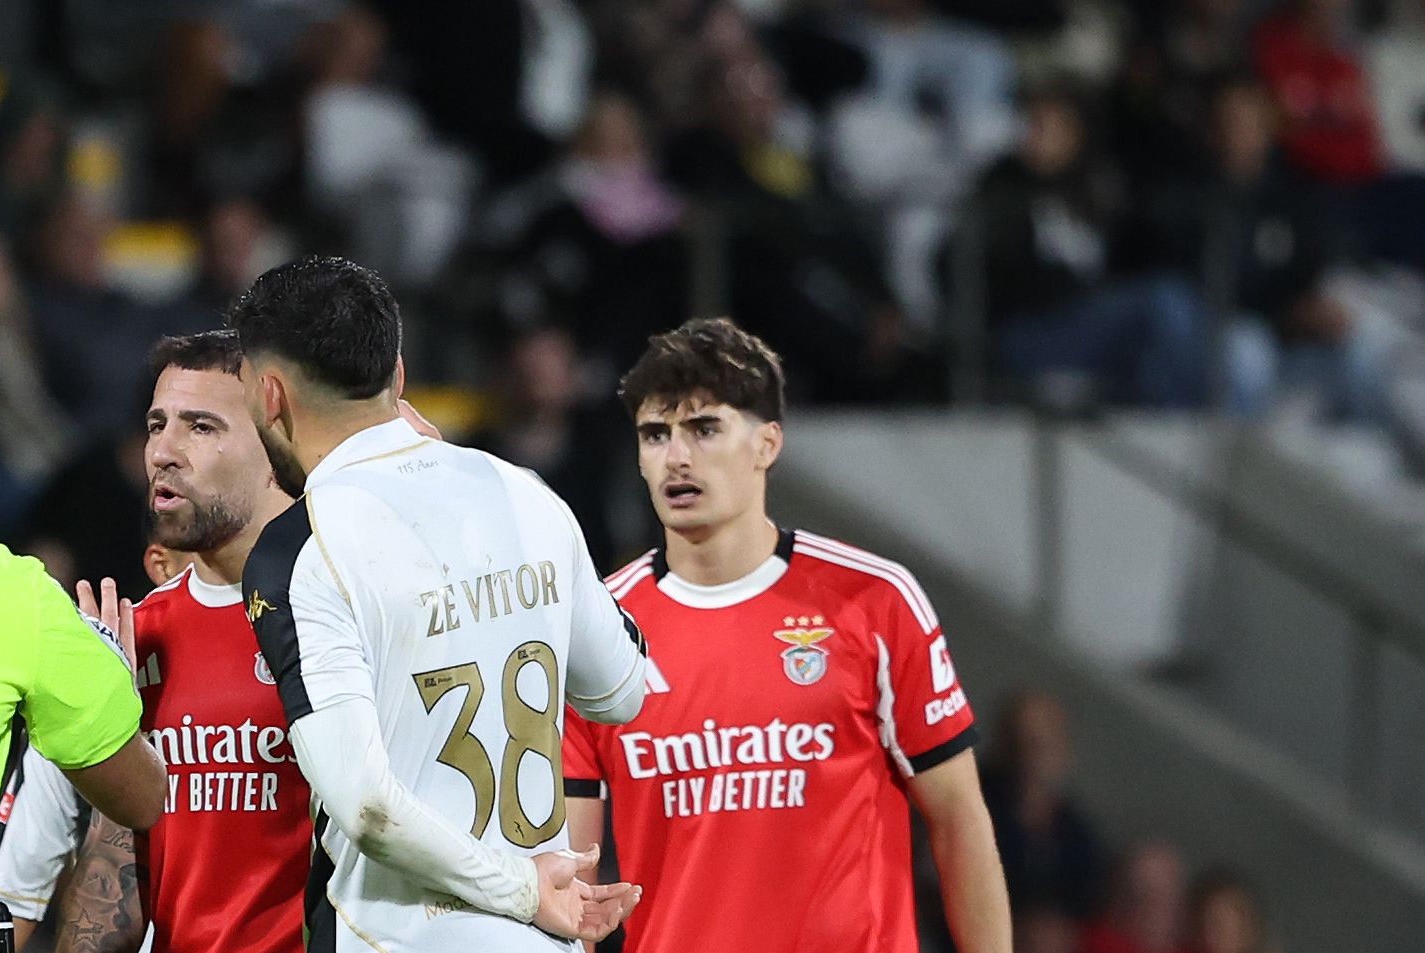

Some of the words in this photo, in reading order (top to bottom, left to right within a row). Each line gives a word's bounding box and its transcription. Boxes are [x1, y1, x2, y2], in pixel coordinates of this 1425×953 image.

[411, 640, 567, 849] 38
[618, 717, 836, 780] Emirates
[189, 772, 278, 812] BETTER
[662, 776, 706, 818] FLY
[708, 768, 807, 813] BETTER
